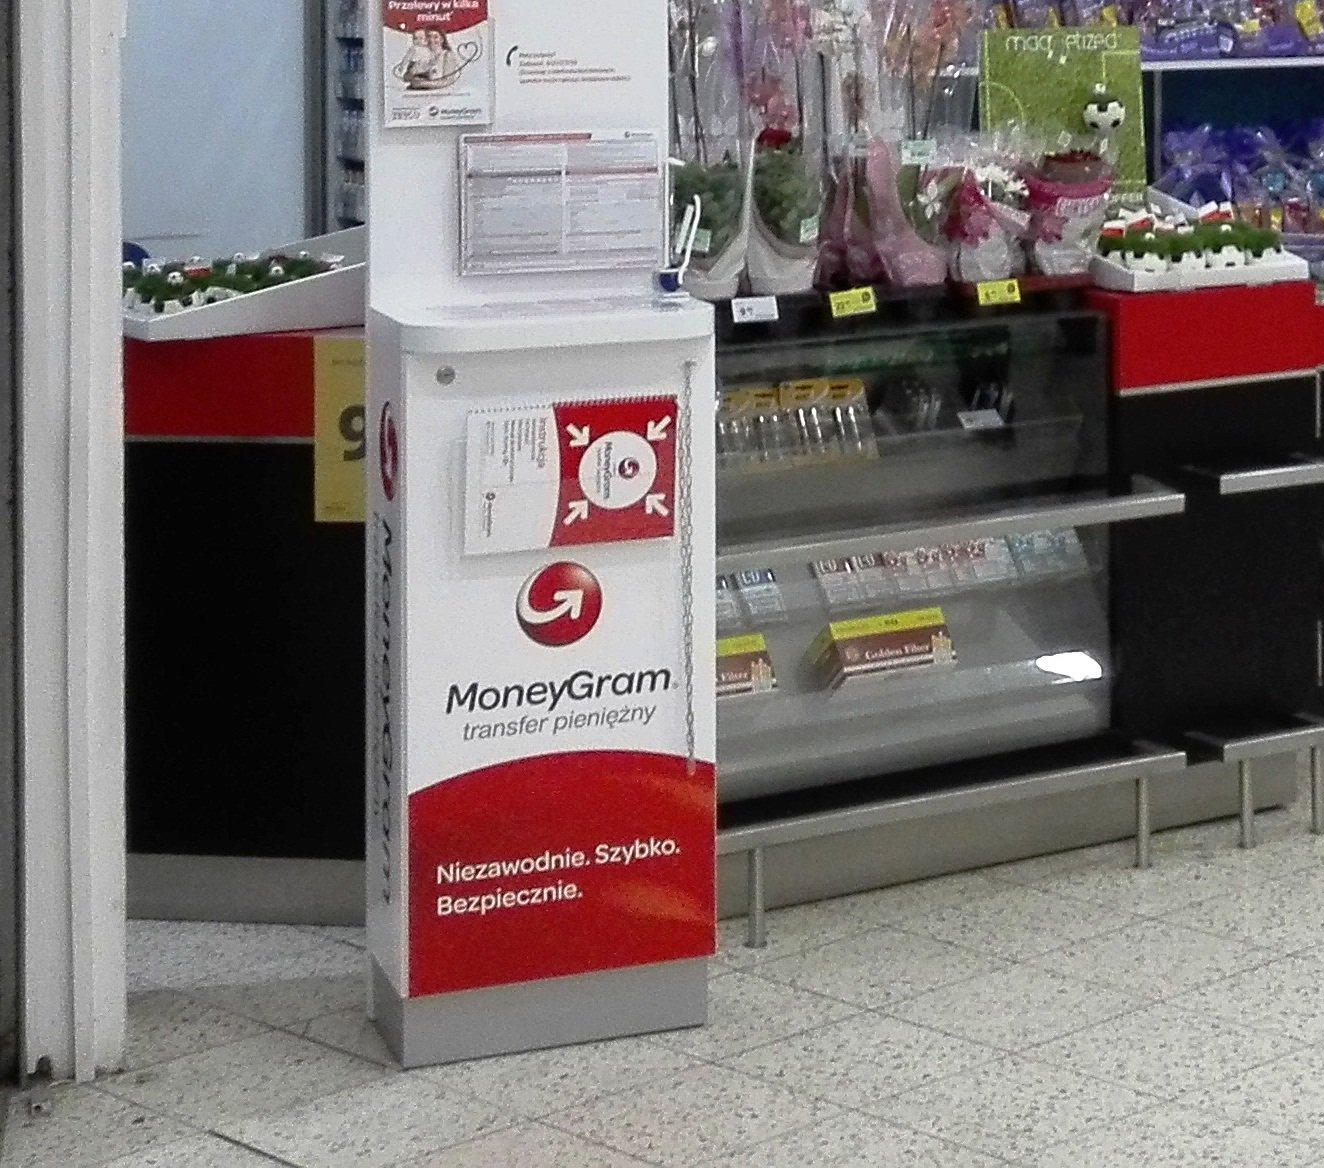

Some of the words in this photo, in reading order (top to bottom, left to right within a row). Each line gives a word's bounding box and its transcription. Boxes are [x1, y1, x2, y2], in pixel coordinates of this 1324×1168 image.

[445, 667, 672, 715] MoneyGram
[462, 714, 549, 741] transfer
[552, 704, 657, 735] pieniężny
[436, 847, 591, 885] Niezawodnie.
[595, 837, 681, 866] Szybko.
[436, 879, 583, 917] Bezpiecznie.
